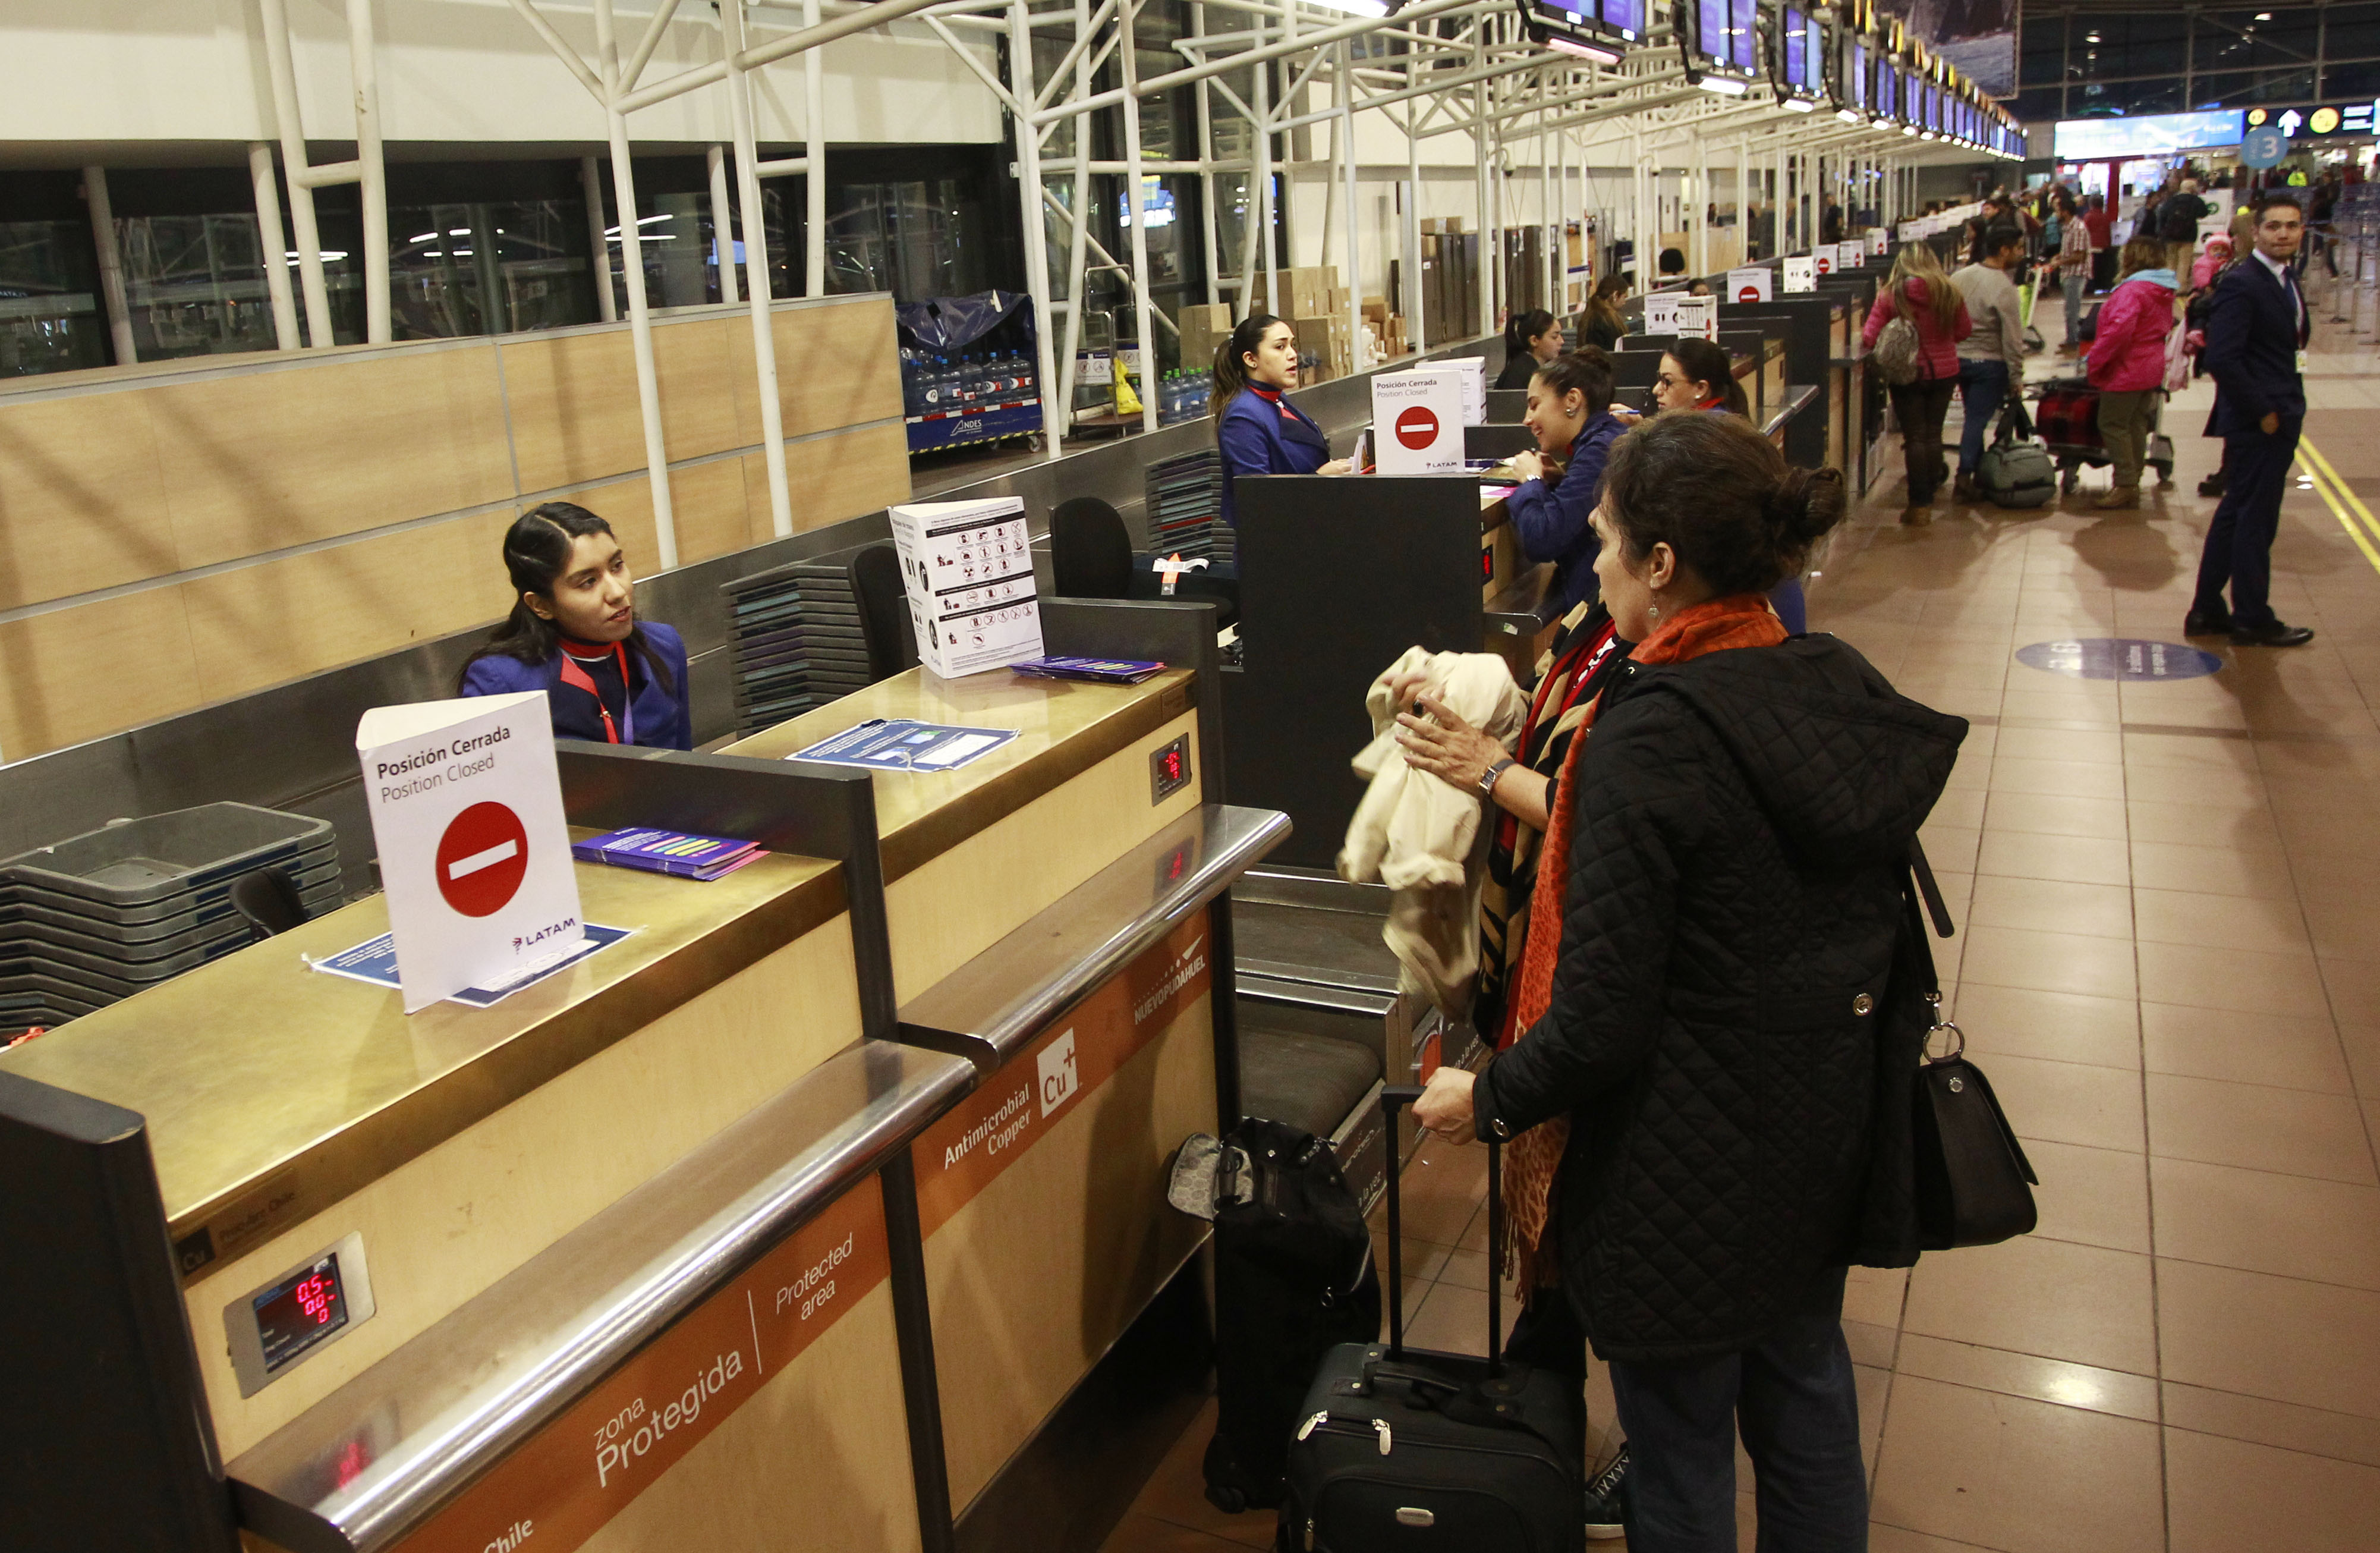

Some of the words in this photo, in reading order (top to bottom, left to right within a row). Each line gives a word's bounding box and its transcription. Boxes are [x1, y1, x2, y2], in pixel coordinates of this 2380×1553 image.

[2261, 136, 2278, 159] 3
[1409, 379, 1437, 387] Cerrada
[950, 419, 981, 436] ANDES
[377, 747, 446, 779] Posición
[452, 726, 511, 755] Cerrada
[381, 774, 442, 803] Position
[447, 752, 495, 782] Closed
[526, 917, 575, 945] LATAM
[945, 1082, 1030, 1170] Antimicrobial
[988, 1109, 1031, 1155] Copper
[777, 1232, 852, 1315] Protected
[801, 1280, 835, 1321] area
[594, 1398, 646, 1450] zona
[596, 1350, 743, 1488] Protegida
